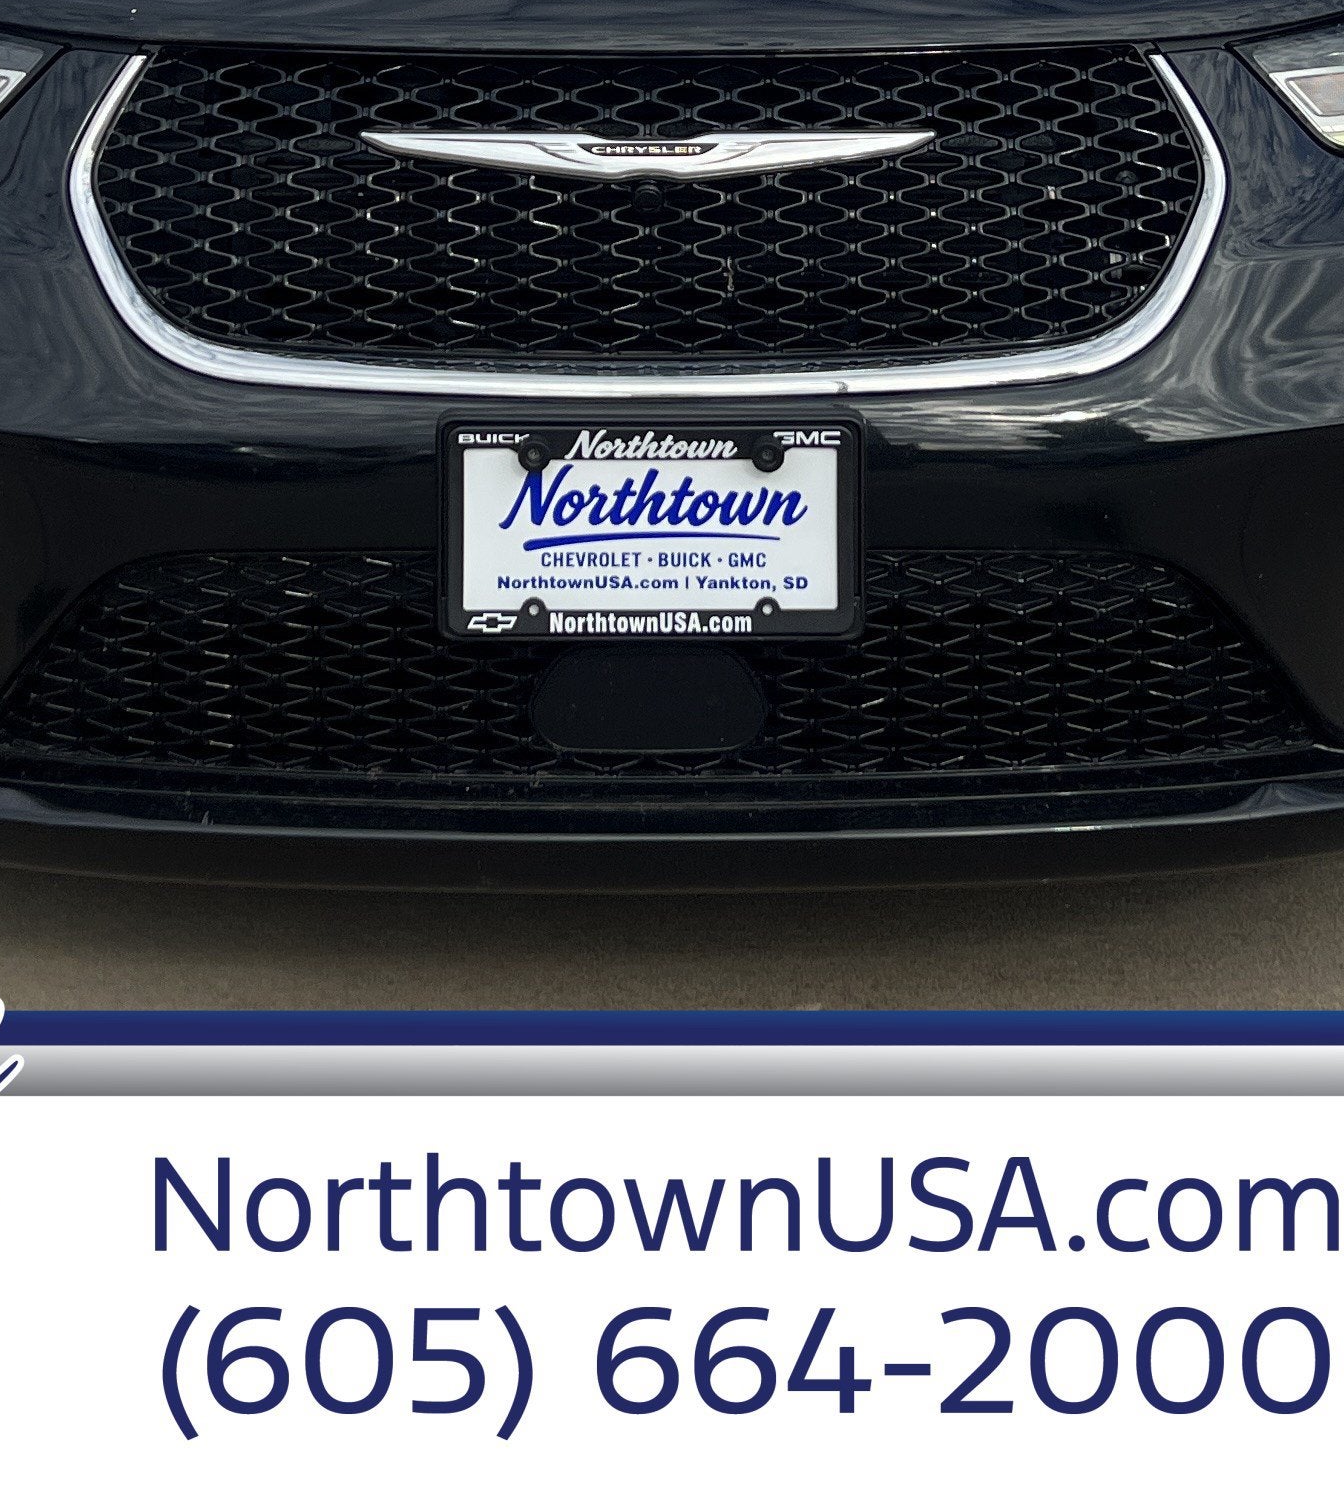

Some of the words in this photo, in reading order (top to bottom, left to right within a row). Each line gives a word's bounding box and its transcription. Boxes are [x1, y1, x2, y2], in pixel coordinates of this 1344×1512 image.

[591, 145, 702, 154] CHRYSLER
[458, 433, 530, 444] BUICK
[564, 429, 738, 459] Northtown
[773, 430, 841, 445] GMC
[498, 464, 808, 529] Northtown
[540, 552, 641, 568] CHEVROLET
[658, 552, 711, 567] BUICK
[728, 552, 767, 568] GMC
[497, 576, 679, 590] NorthtownUSA.com
[695, 576, 776, 592] Yankton,
[783, 576, 808, 590] SD
[549, 611, 752, 633] NorthtownUSA.com
